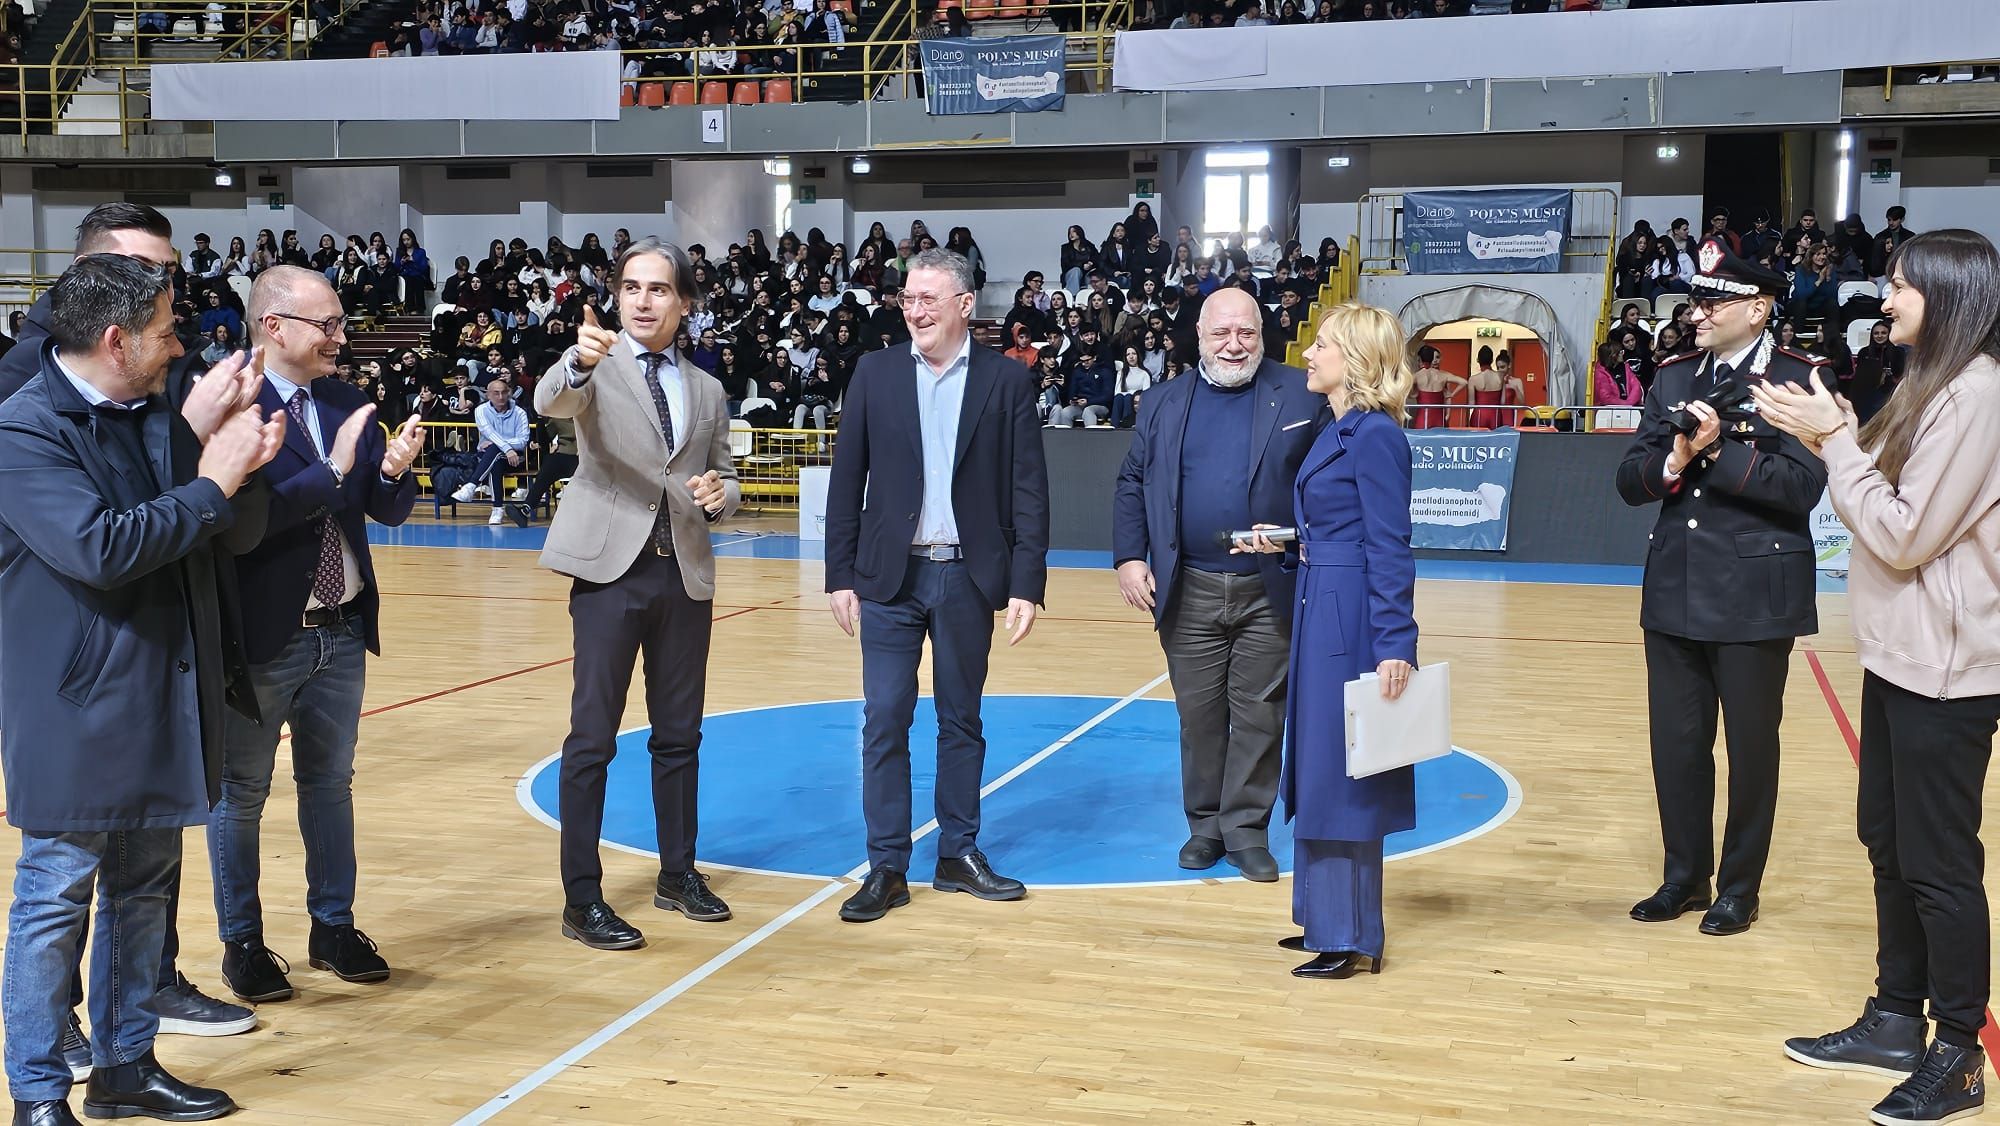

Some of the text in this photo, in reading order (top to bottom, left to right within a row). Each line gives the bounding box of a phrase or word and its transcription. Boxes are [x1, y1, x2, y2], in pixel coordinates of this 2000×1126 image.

[977, 49, 1062, 62] POLY'S MUSIC
[708, 118, 718, 132] 4
[1469, 207, 1566, 220] POLY'S MUSIC
[1440, 446, 1512, 463] MUSIC
